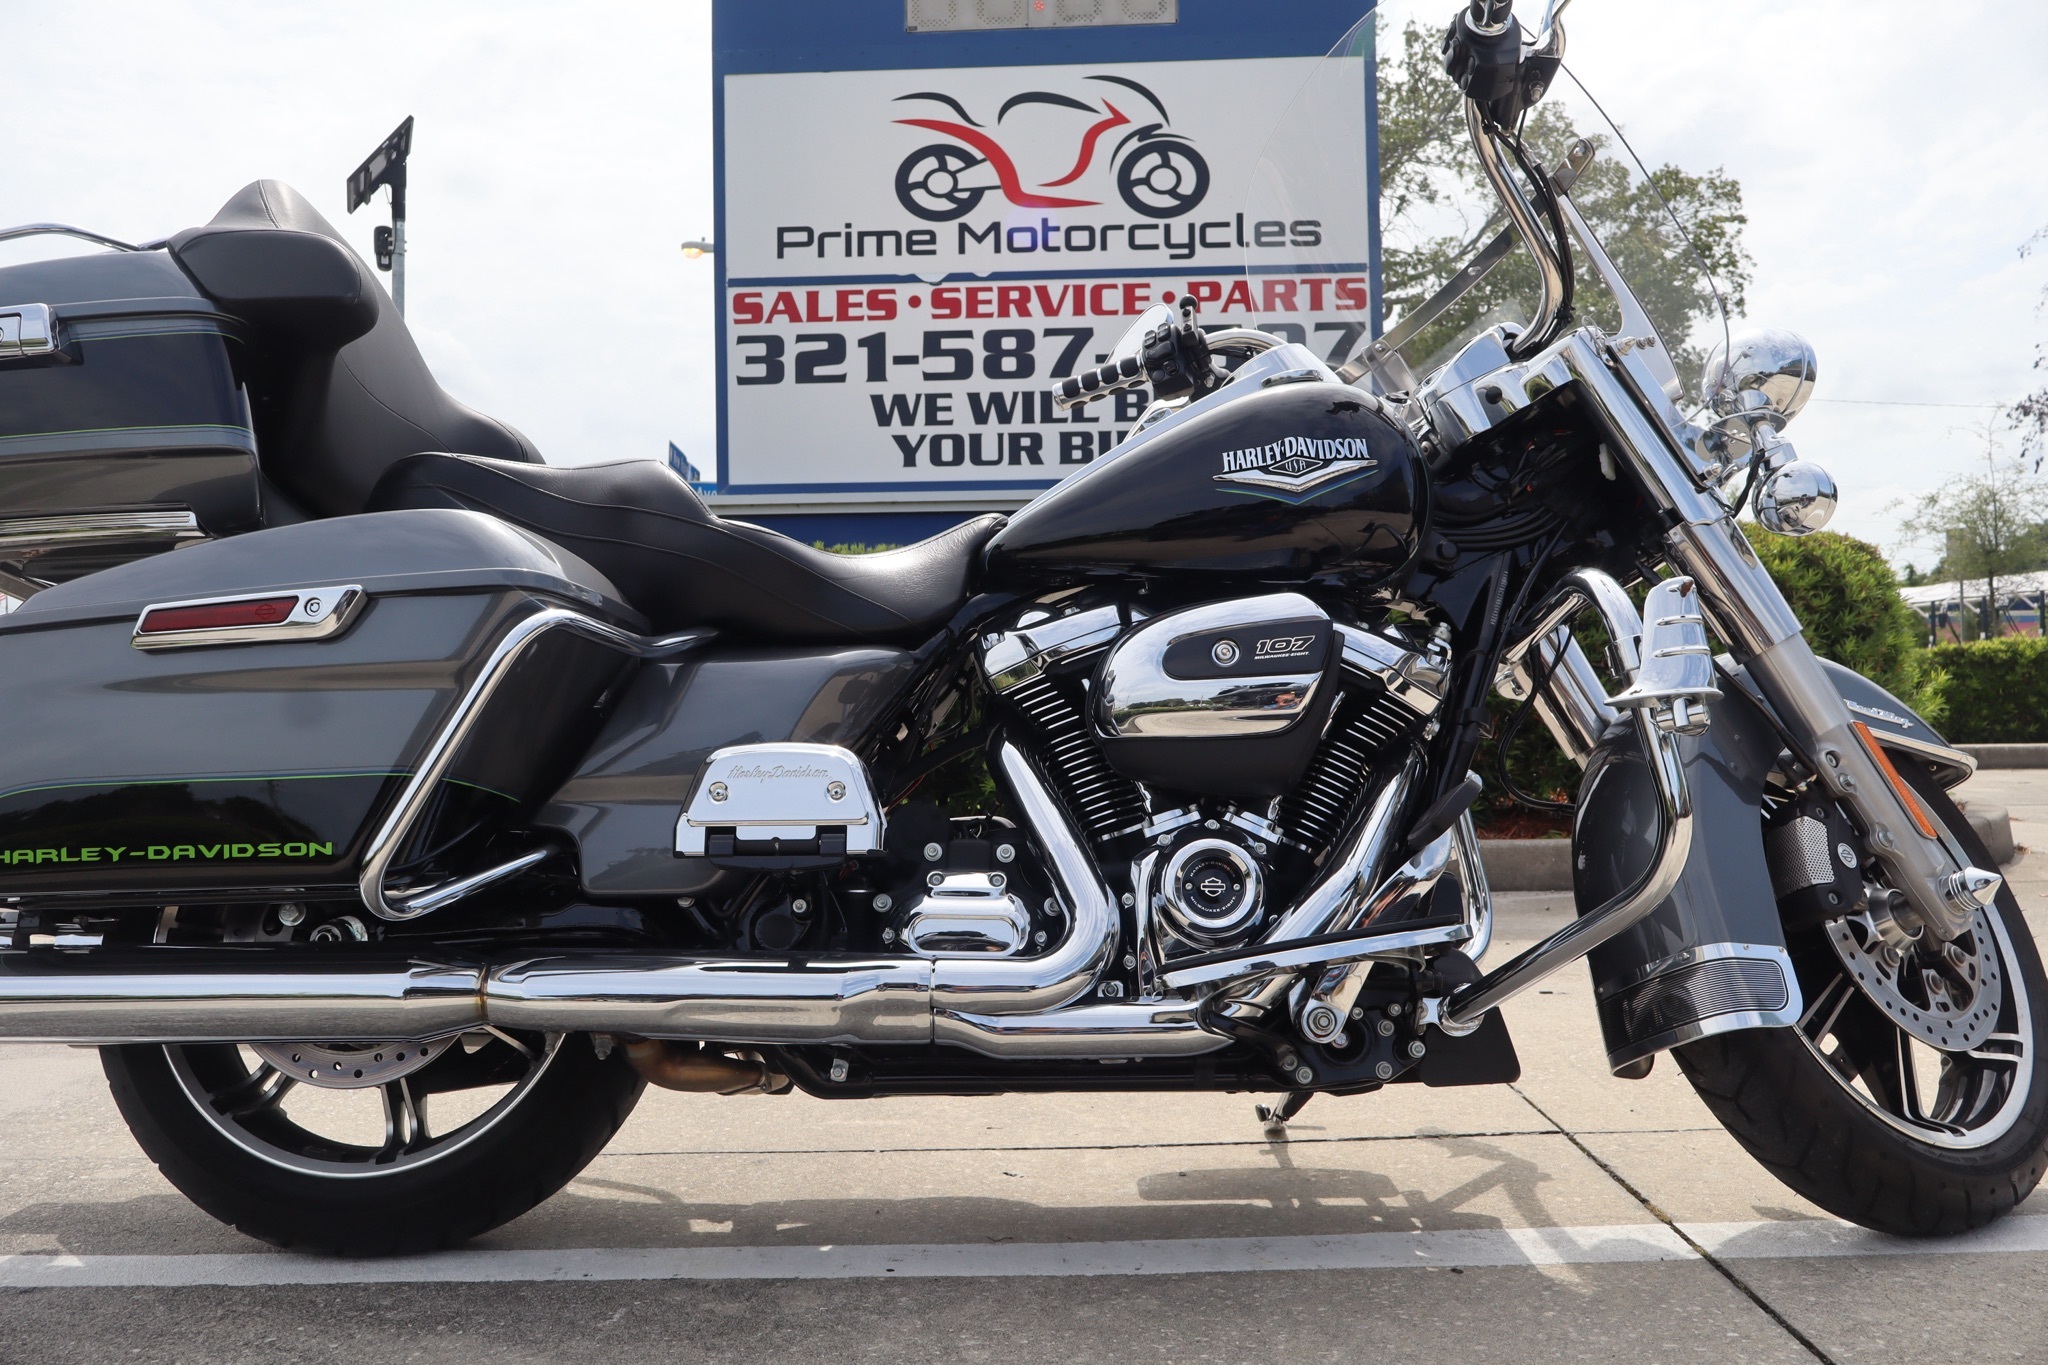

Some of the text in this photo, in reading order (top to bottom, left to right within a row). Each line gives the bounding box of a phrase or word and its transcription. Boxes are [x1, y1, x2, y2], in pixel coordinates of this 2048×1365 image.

[777, 212, 1322, 260] Prime Motorcycles
[732, 277, 1367, 325] SALES SERVICE PARTS
[735, 320, 1367, 386] 321-587-7
[869, 392, 954, 427] WE
[966, 390, 1100, 425] WILL
[891, 431, 1045, 468] YOUR
[1222, 436, 1370, 473] HARLEY-DAVIDSON
[1285, 459, 1307, 474] USA
[1256, 634, 1316, 655] 107
